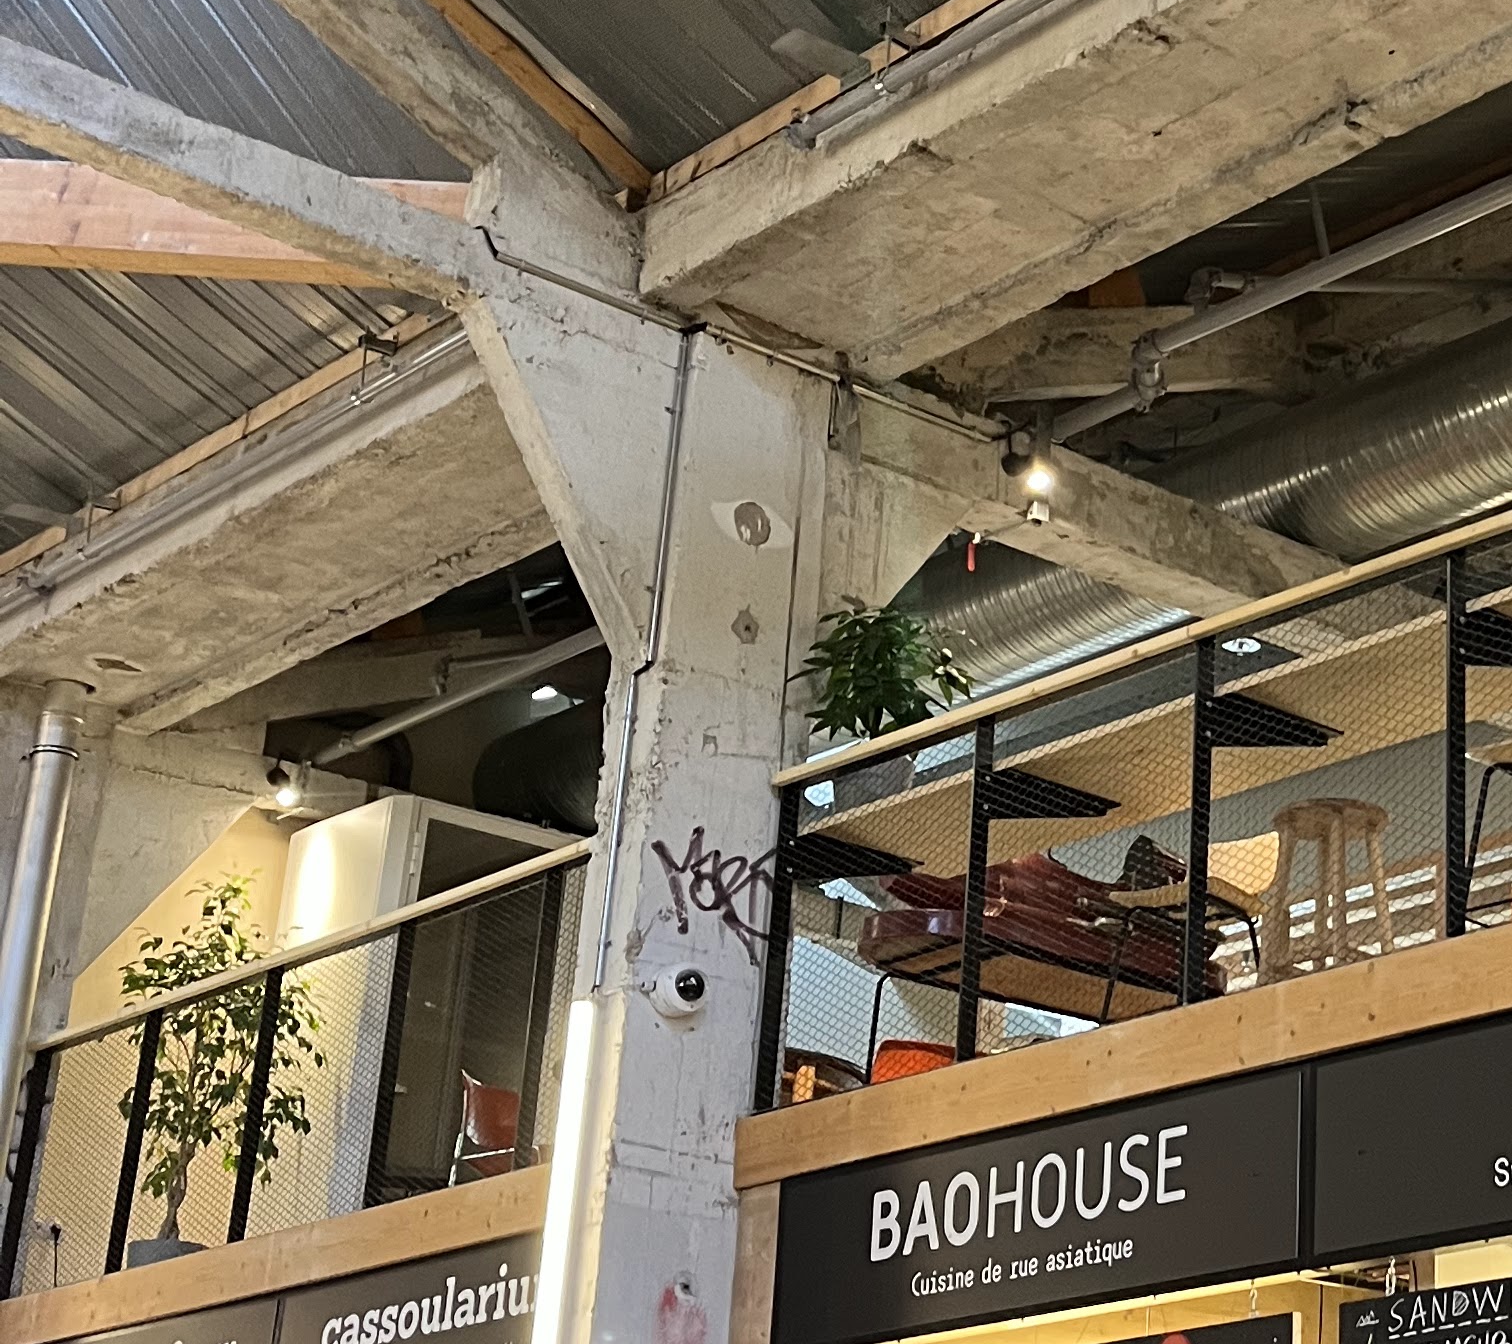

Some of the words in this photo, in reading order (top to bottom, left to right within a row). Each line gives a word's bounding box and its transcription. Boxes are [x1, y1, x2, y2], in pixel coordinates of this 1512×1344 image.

[870, 1124, 1188, 1262] BAOHOUSE
[911, 1266, 974, 1297] Cuisine
[981, 1257, 1002, 1284] de
[1009, 1258, 1038, 1281] rue
[1045, 1238, 1134, 1273] asiatique
